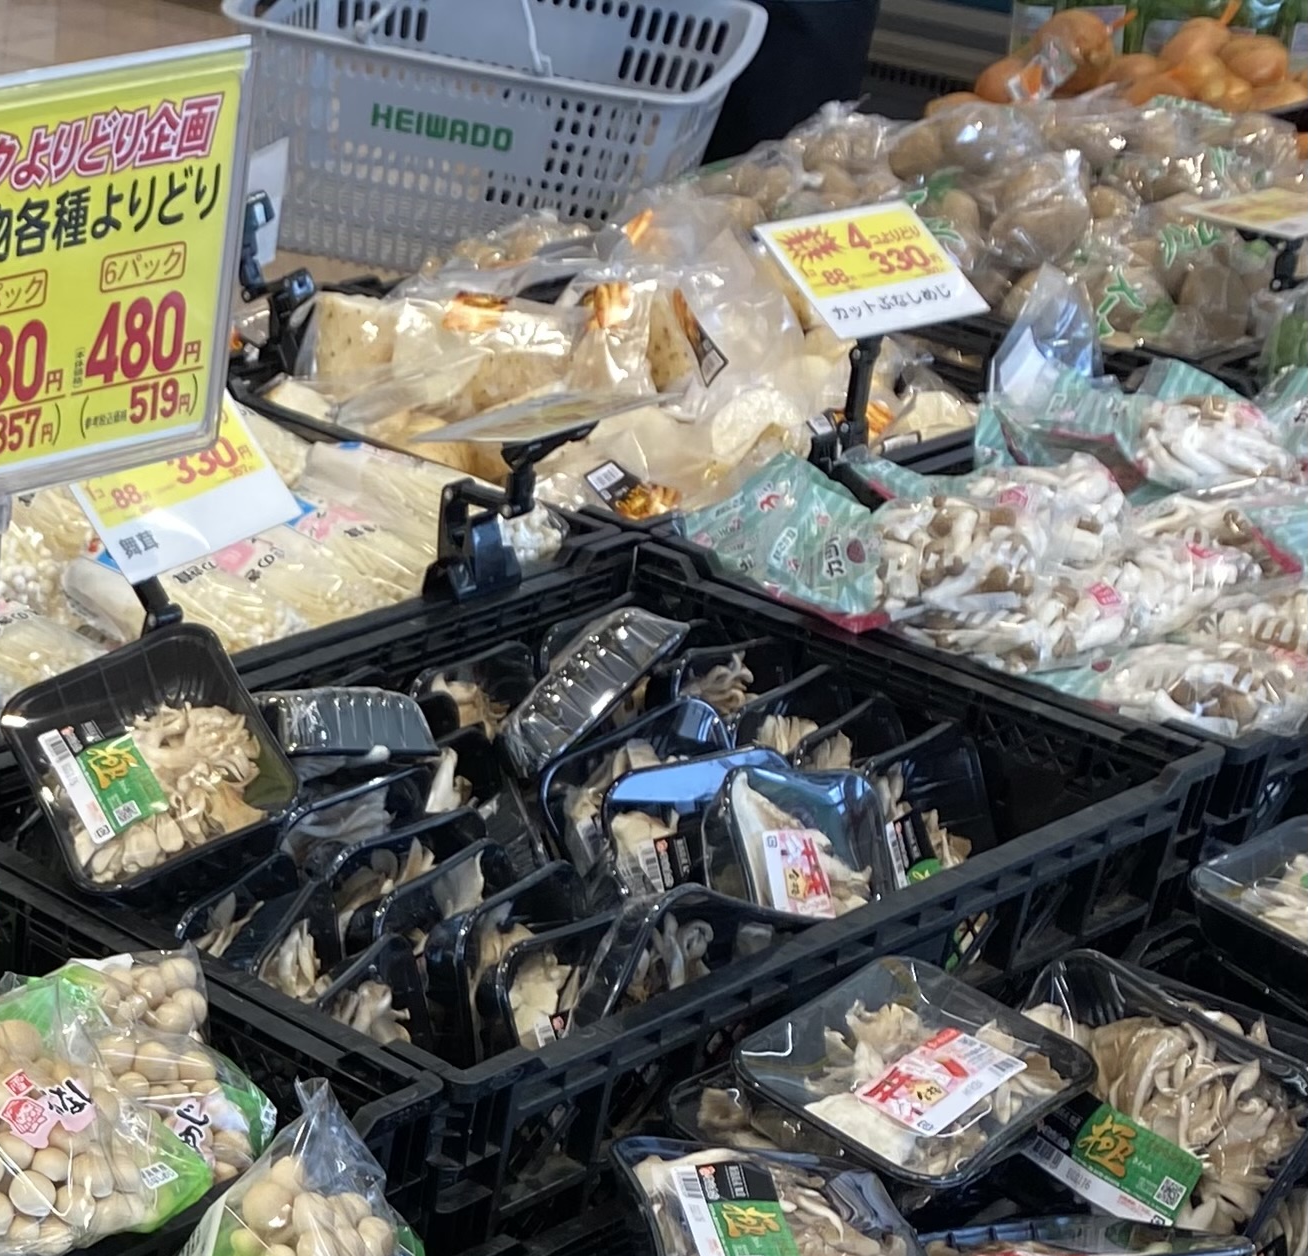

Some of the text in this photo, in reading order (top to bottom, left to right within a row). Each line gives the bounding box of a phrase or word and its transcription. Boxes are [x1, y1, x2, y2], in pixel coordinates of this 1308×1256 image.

[371, 104, 513, 152] HEIWADO
[104, 253, 183, 286] 6パック
[832, 285, 952, 320] カットぶなしめじ
[118, 530, 160, 560] 舞茸
